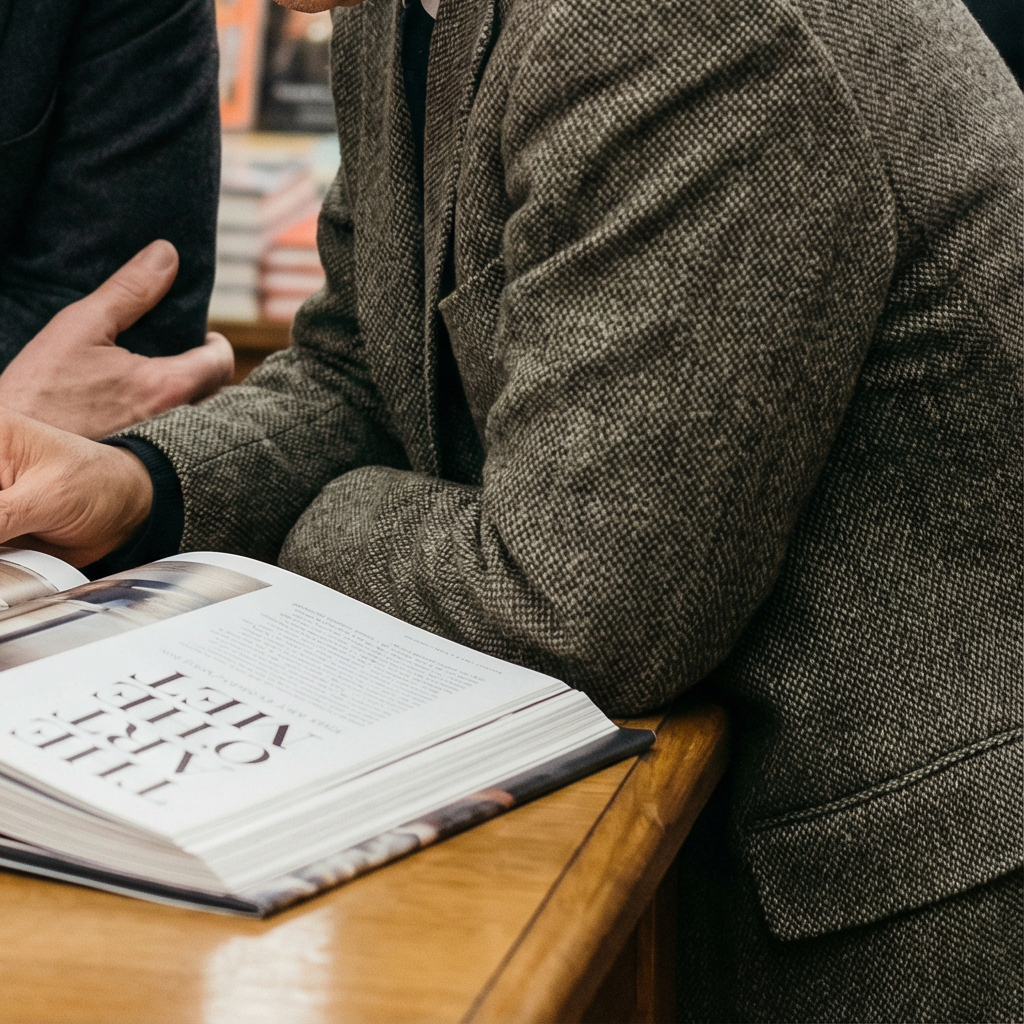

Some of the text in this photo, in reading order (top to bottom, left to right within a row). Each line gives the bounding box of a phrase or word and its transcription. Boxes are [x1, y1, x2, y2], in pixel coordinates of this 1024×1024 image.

[52, 709, 234, 774] ART
[129, 671, 323, 749] MET
[10, 718, 172, 805] THE
